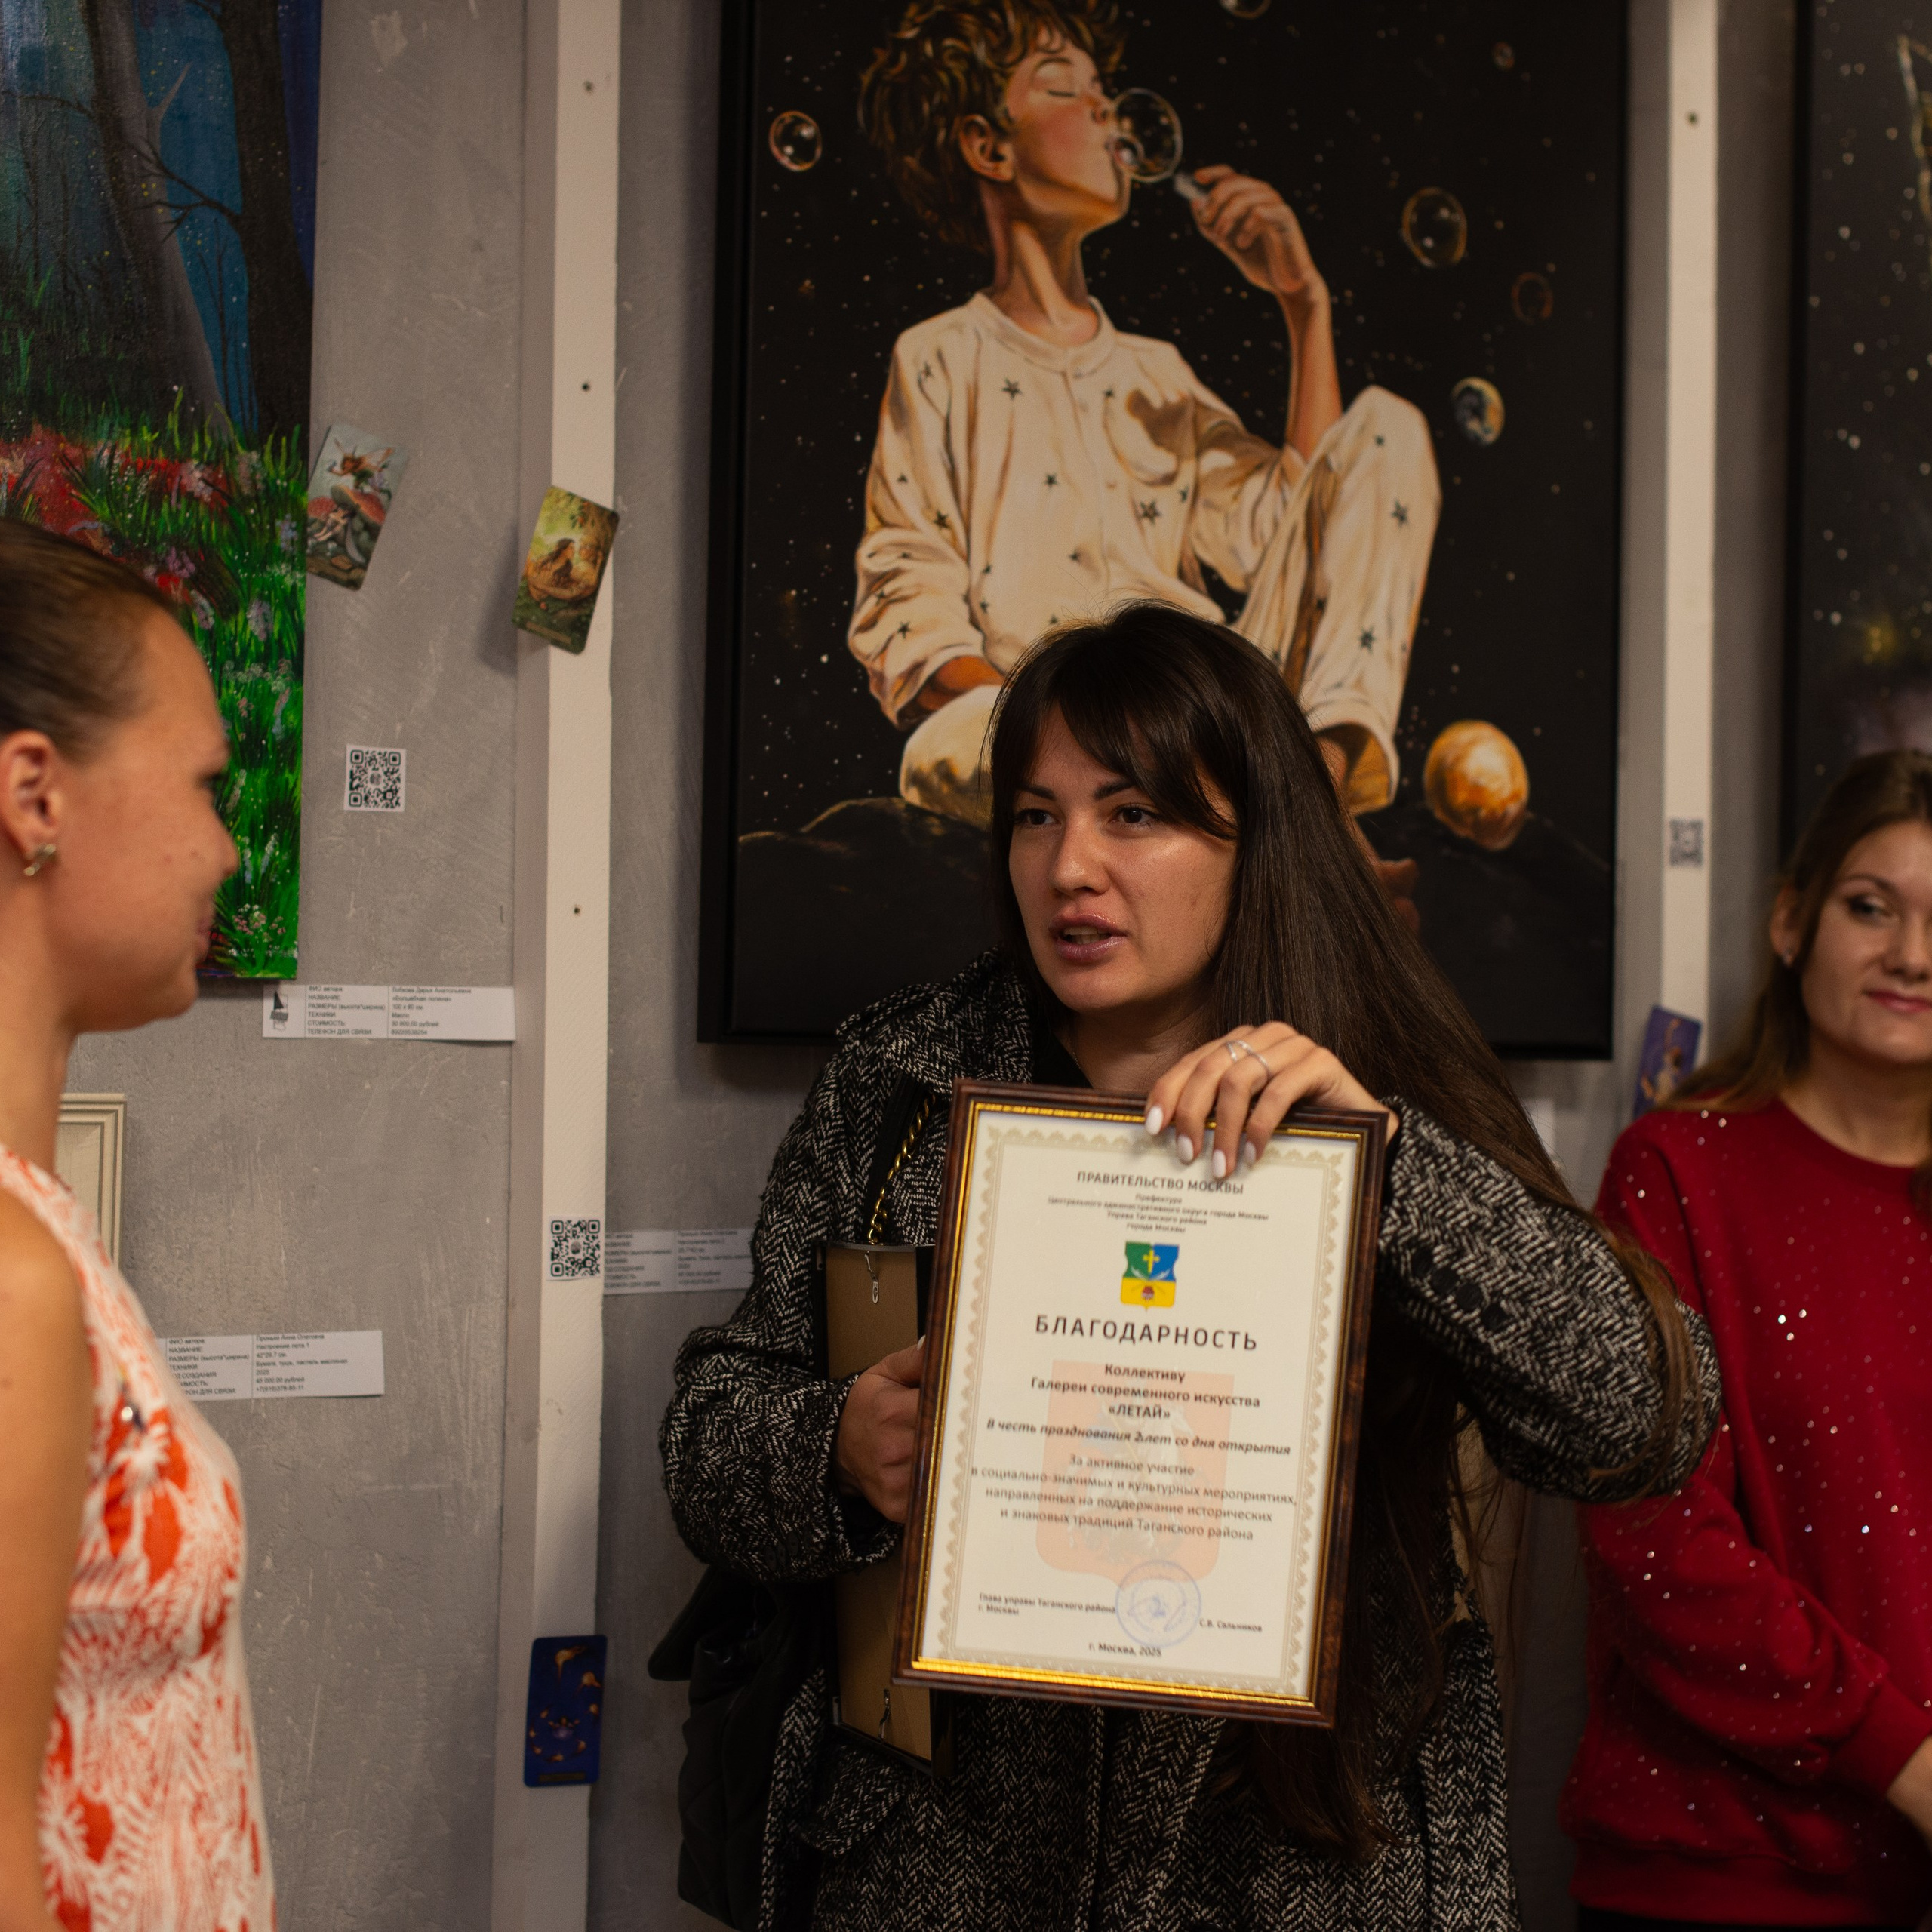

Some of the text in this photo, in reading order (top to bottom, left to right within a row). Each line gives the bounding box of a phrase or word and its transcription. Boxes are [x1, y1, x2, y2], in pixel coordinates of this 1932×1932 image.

[1077, 1171, 1244, 1195] ПРАВИТЕЛЬСТВО МОСКВЫ
[1048, 1195, 1269, 1221] Центрального административного округа города Москвы
[1135, 1193, 1183, 1204] Префектура
[1107, 1211, 1208, 1226] Управа Таганского района
[1126, 1223, 1186, 1233] города Москвы
[1035, 1315, 1257, 1351] БЛАГОДАРНОСТЬ
[1105, 1364, 1186, 1383] Коллективу
[1031, 1377, 1260, 1408] Галереи современного искусства
[1109, 1404, 1171, 1419] «ЛЕТАЙ»
[986, 1420, 995, 1430] В
[998, 1422, 1037, 1435] честь
[1040, 1425, 1131, 1442] празднования
[1175, 1437, 1189, 1447] со
[1192, 1435, 1215, 1450] дня
[1218, 1439, 1291, 1457] открытия
[1069, 1454, 1195, 1477] За активное участие
[971, 1467, 1297, 1506] в социально-значимых и культурных мероприятиях,
[986, 1487, 1273, 1523] направленных на поддержание исторических
[1001, 1509, 1254, 1542] и знаковых традиций Таганского района
[979, 1592, 1116, 1614] Глава управы Таганского района
[986, 1604, 1019, 1616] Москвы
[1099, 1642, 1137, 1657] Москва,
[1139, 1646, 1162, 1657] 2025
